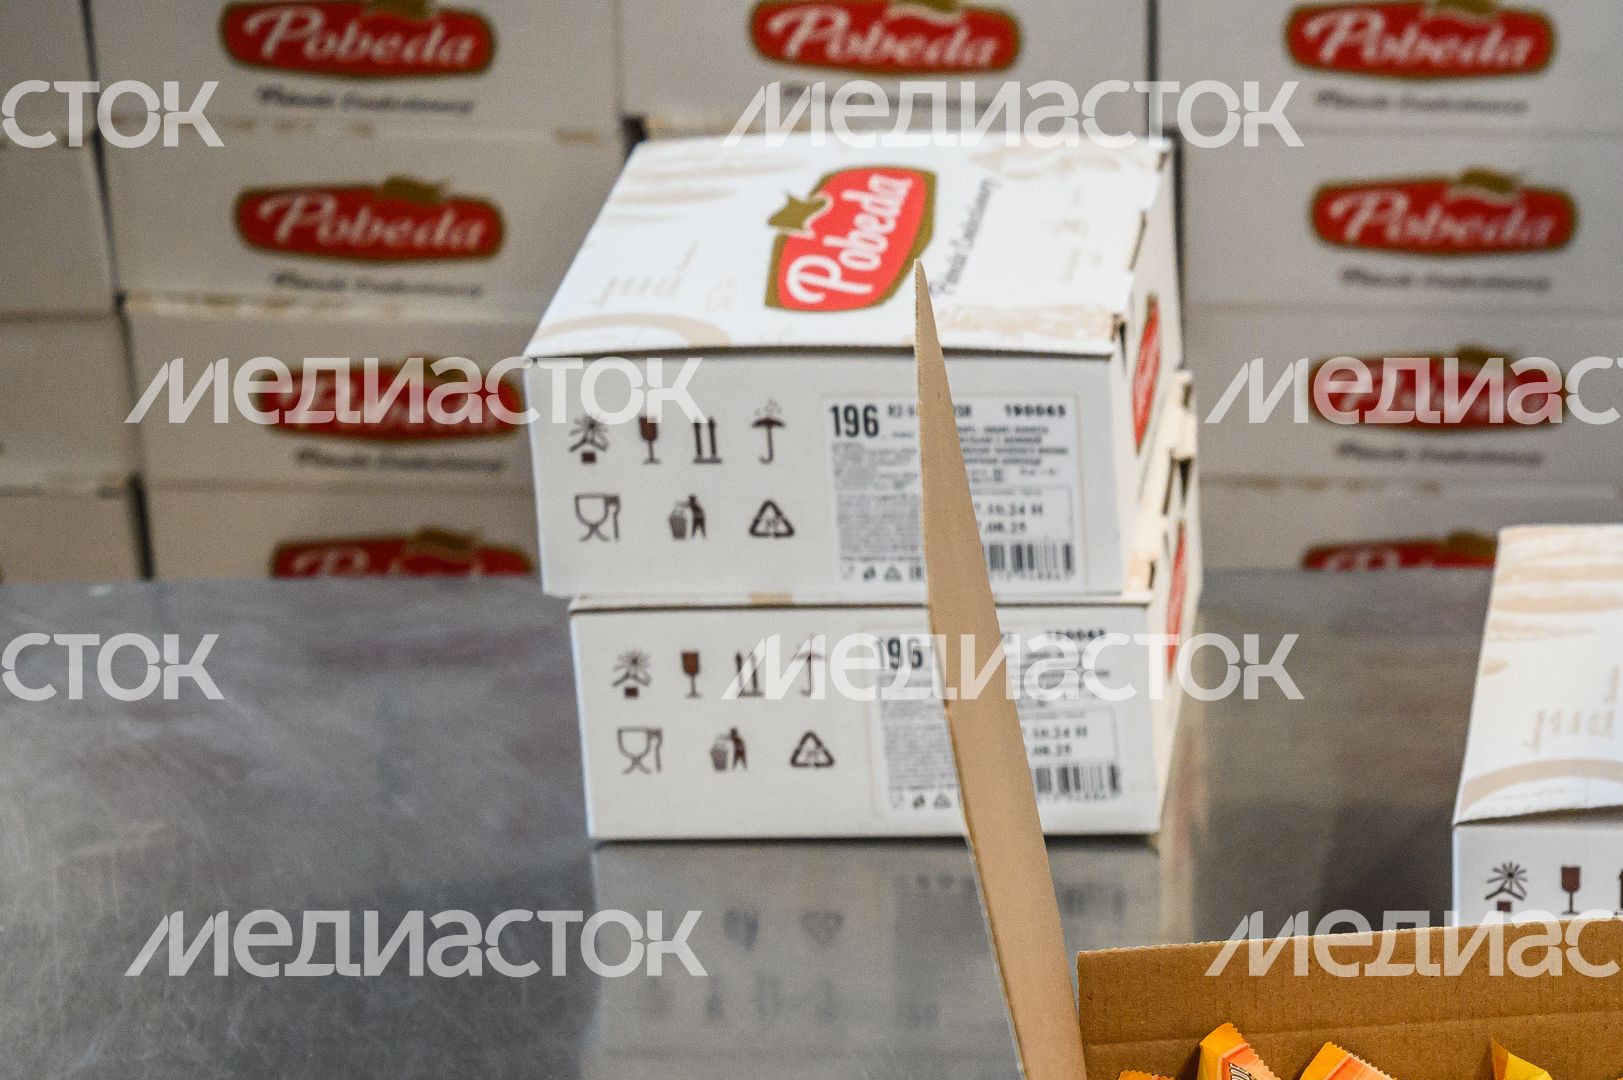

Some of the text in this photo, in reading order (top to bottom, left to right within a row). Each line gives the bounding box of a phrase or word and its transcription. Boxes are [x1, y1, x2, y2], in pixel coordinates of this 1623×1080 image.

[246, 6, 473, 67] Pobeda
[768, 4, 998, 66] Pobeda
[1303, 10, 1532, 73] Pobeda
[260, 195, 487, 254] Pobeda
[784, 170, 913, 304] Pobeda
[1329, 187, 1556, 251] Pobeda
[830, 404, 879, 438] 196
